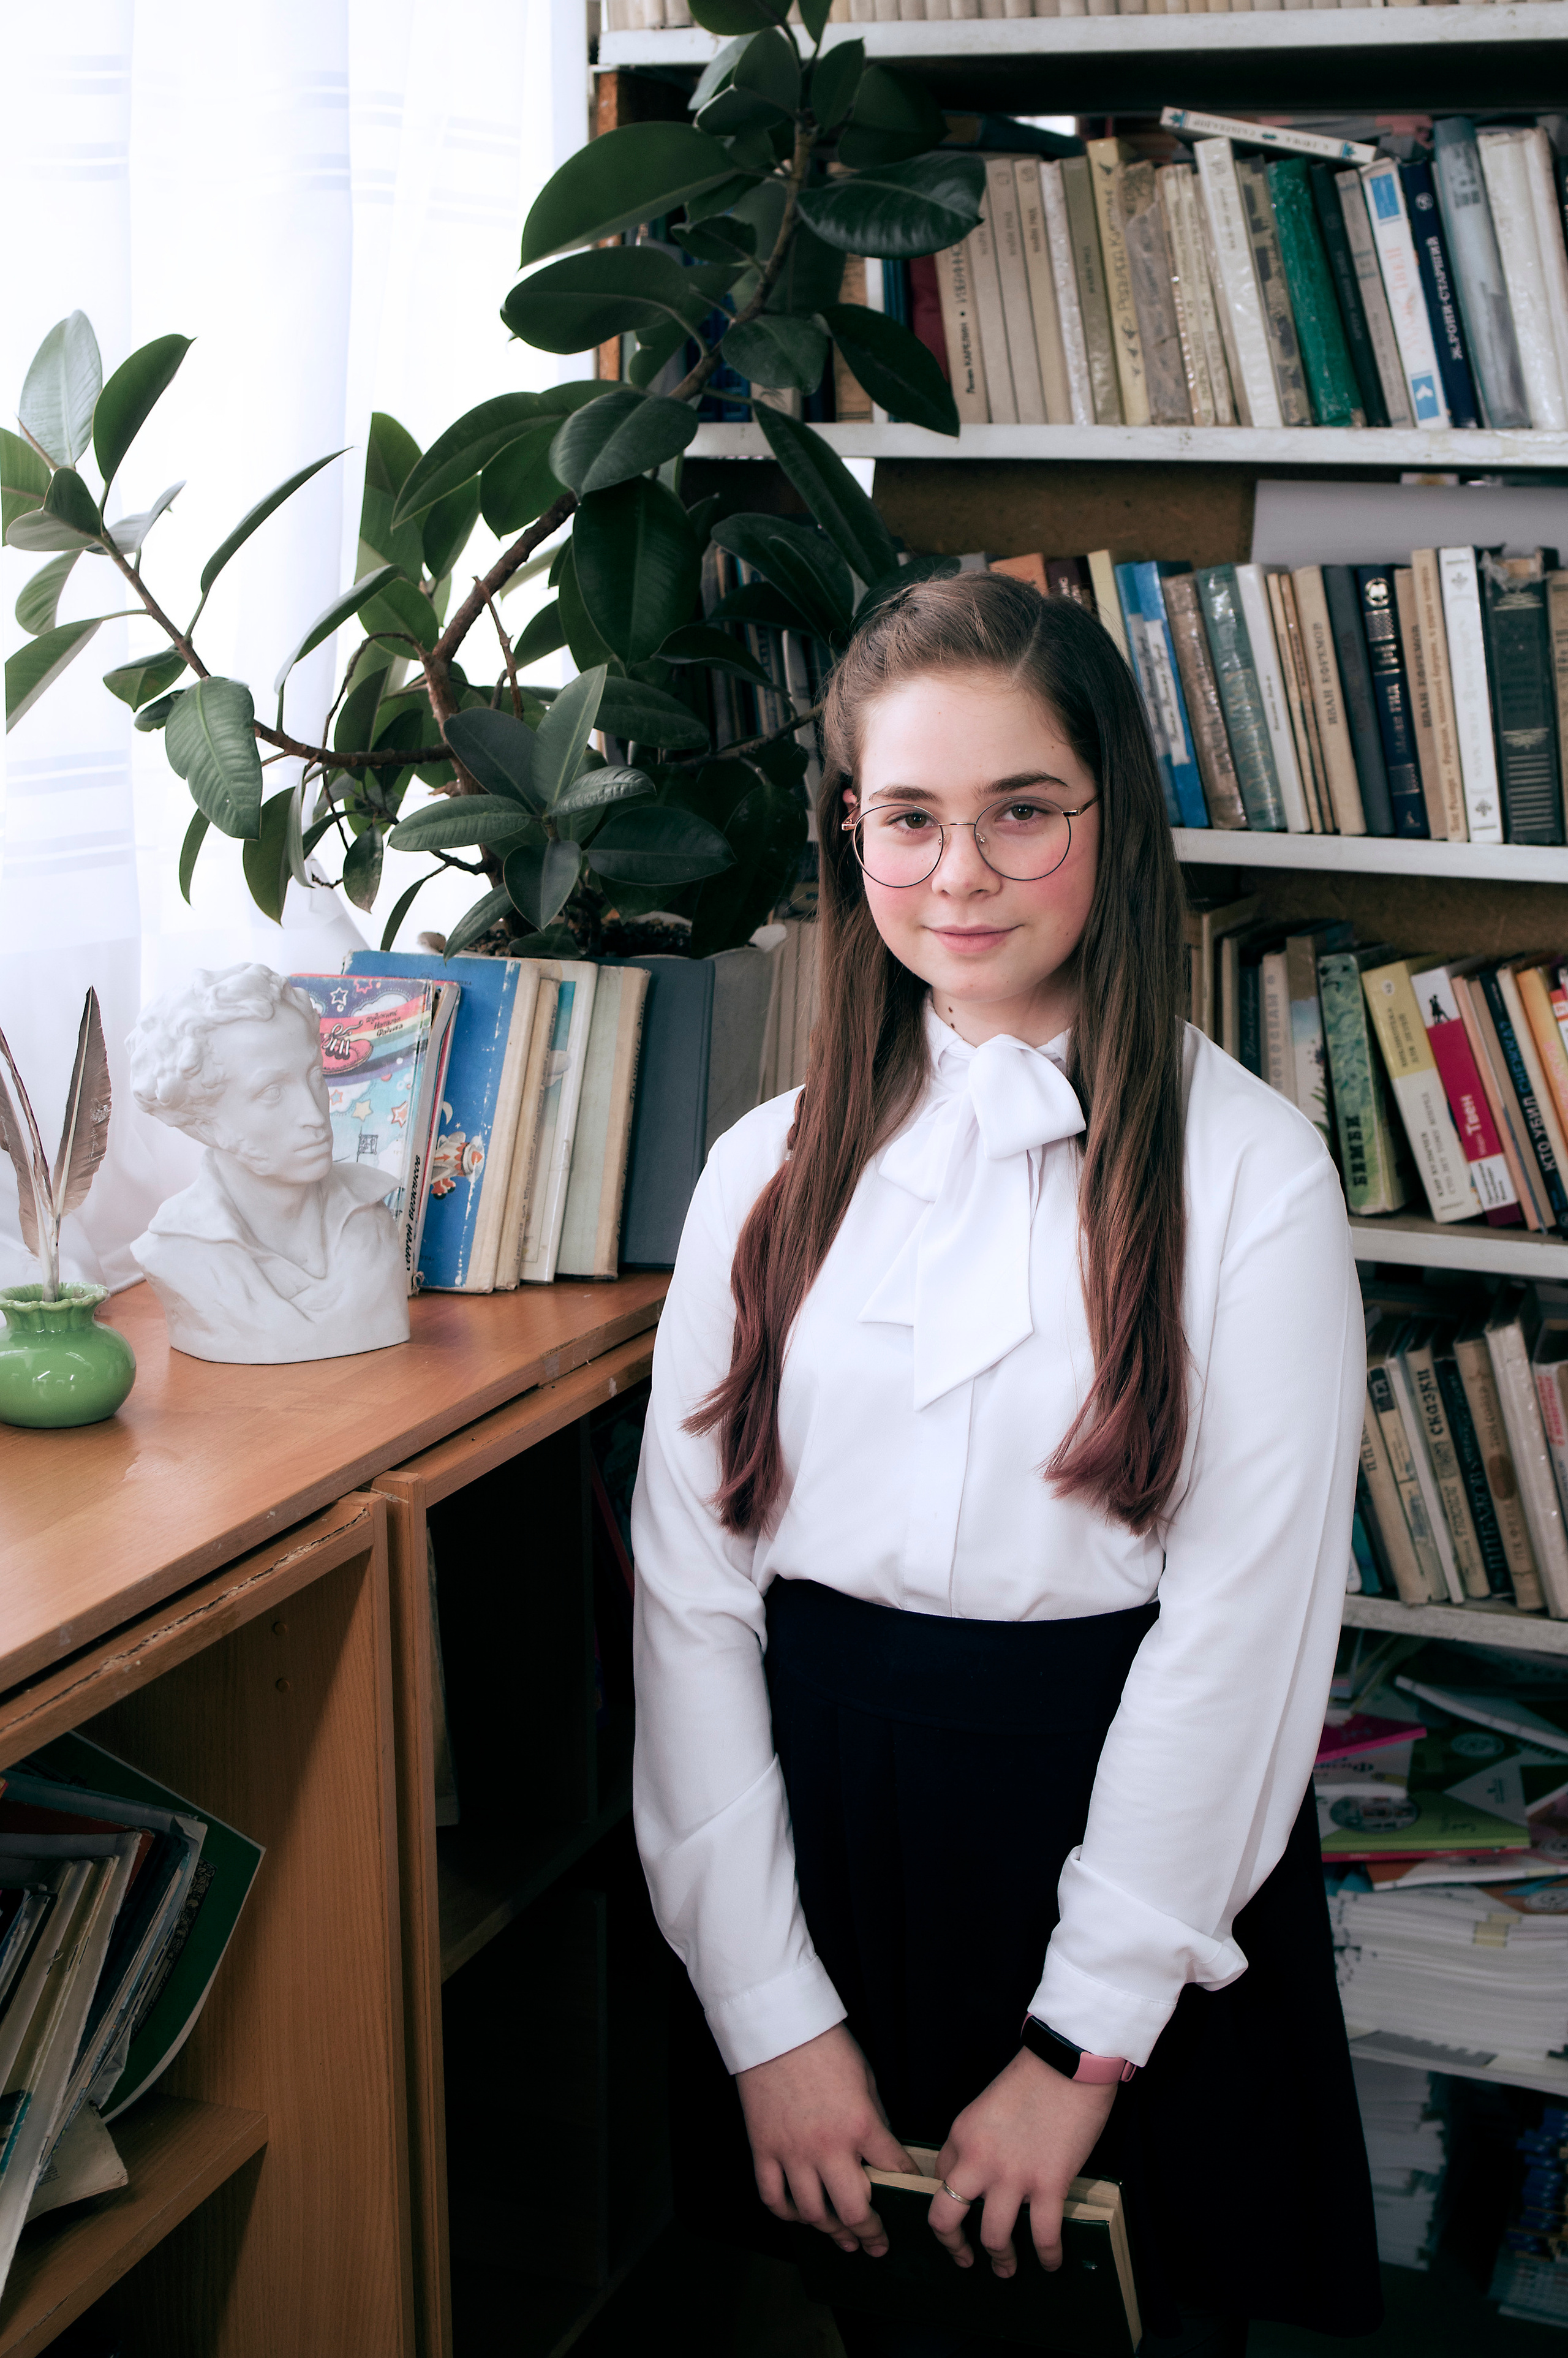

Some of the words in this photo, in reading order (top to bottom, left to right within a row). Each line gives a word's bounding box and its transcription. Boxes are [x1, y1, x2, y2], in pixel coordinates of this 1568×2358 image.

[1424, 235, 1464, 361] Ж.РОНИ-СТАРШИЙ
[1312, 621, 1332, 684] ЕФРЕМОВ
[1322, 689, 1338, 725] ИВАН
[1523, 1095, 1546, 1138] УБИЛ
[1536, 1139, 1558, 1171] КТО
